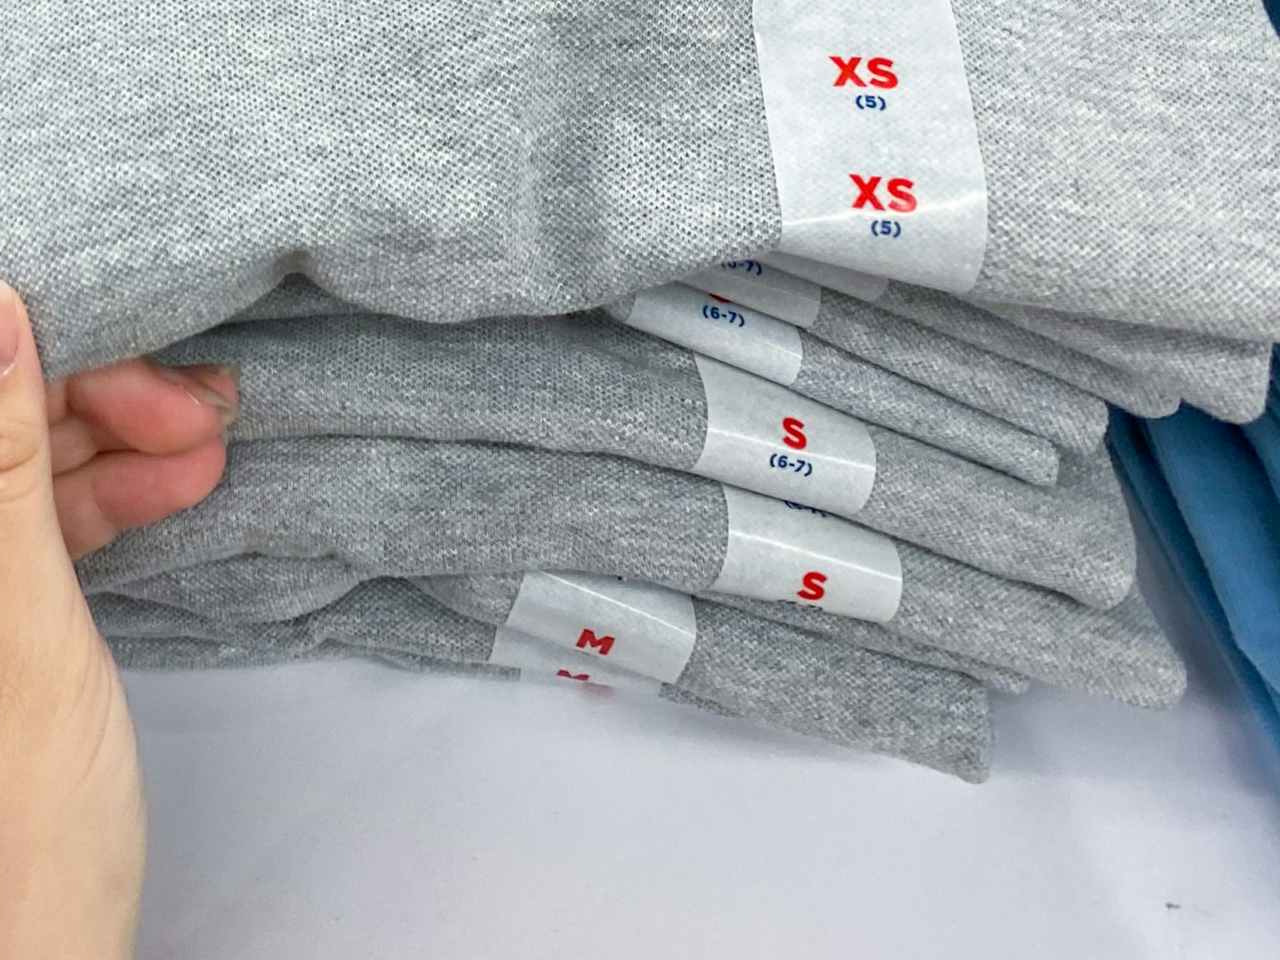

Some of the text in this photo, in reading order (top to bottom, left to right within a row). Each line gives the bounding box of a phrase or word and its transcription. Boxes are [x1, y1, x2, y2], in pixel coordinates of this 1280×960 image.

[829, 56, 899, 89] XS
[855, 95, 887, 111] (5)
[849, 174, 919, 213] XS
[871, 220, 902, 238] (5)
[703, 305, 745, 327] (6-7)
[782, 417, 807, 450] S
[769, 453, 813, 476] (6-7)
[797, 571, 827, 600] S
[576, 628, 615, 655] M
